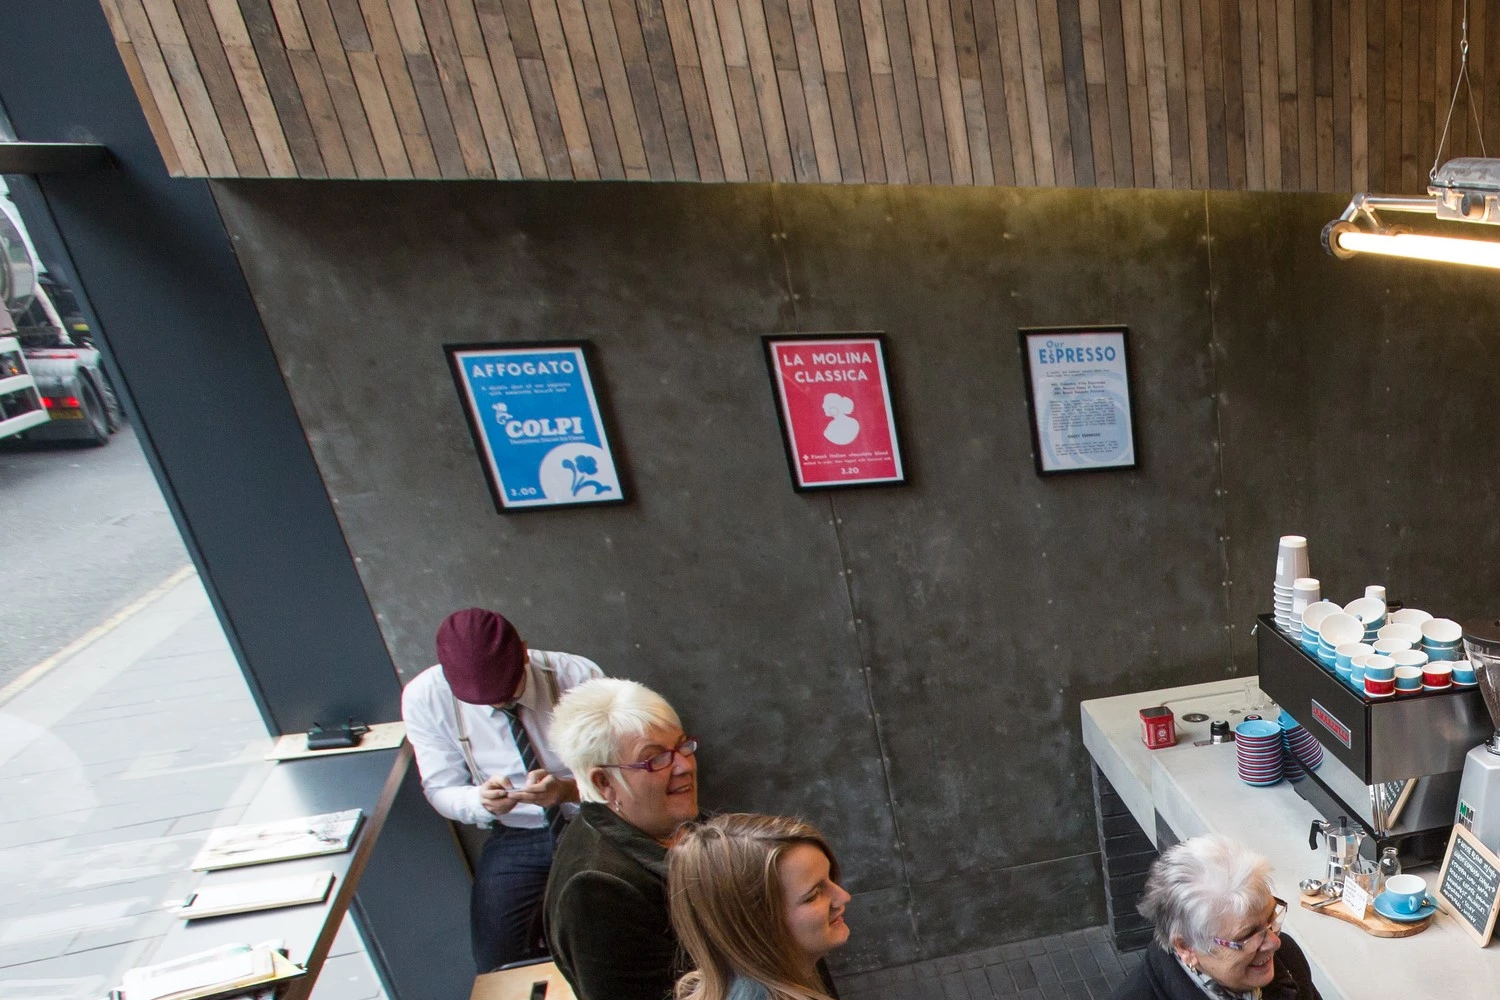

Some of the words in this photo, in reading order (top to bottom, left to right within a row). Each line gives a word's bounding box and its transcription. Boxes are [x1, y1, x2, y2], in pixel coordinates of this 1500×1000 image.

[783, 353, 804, 366] LA
[812, 351, 872, 365] MOLINA
[472, 360, 574, 378] AFFOGATO
[794, 369, 868, 384] CLASSICA
[505, 416, 584, 438] COLPI
